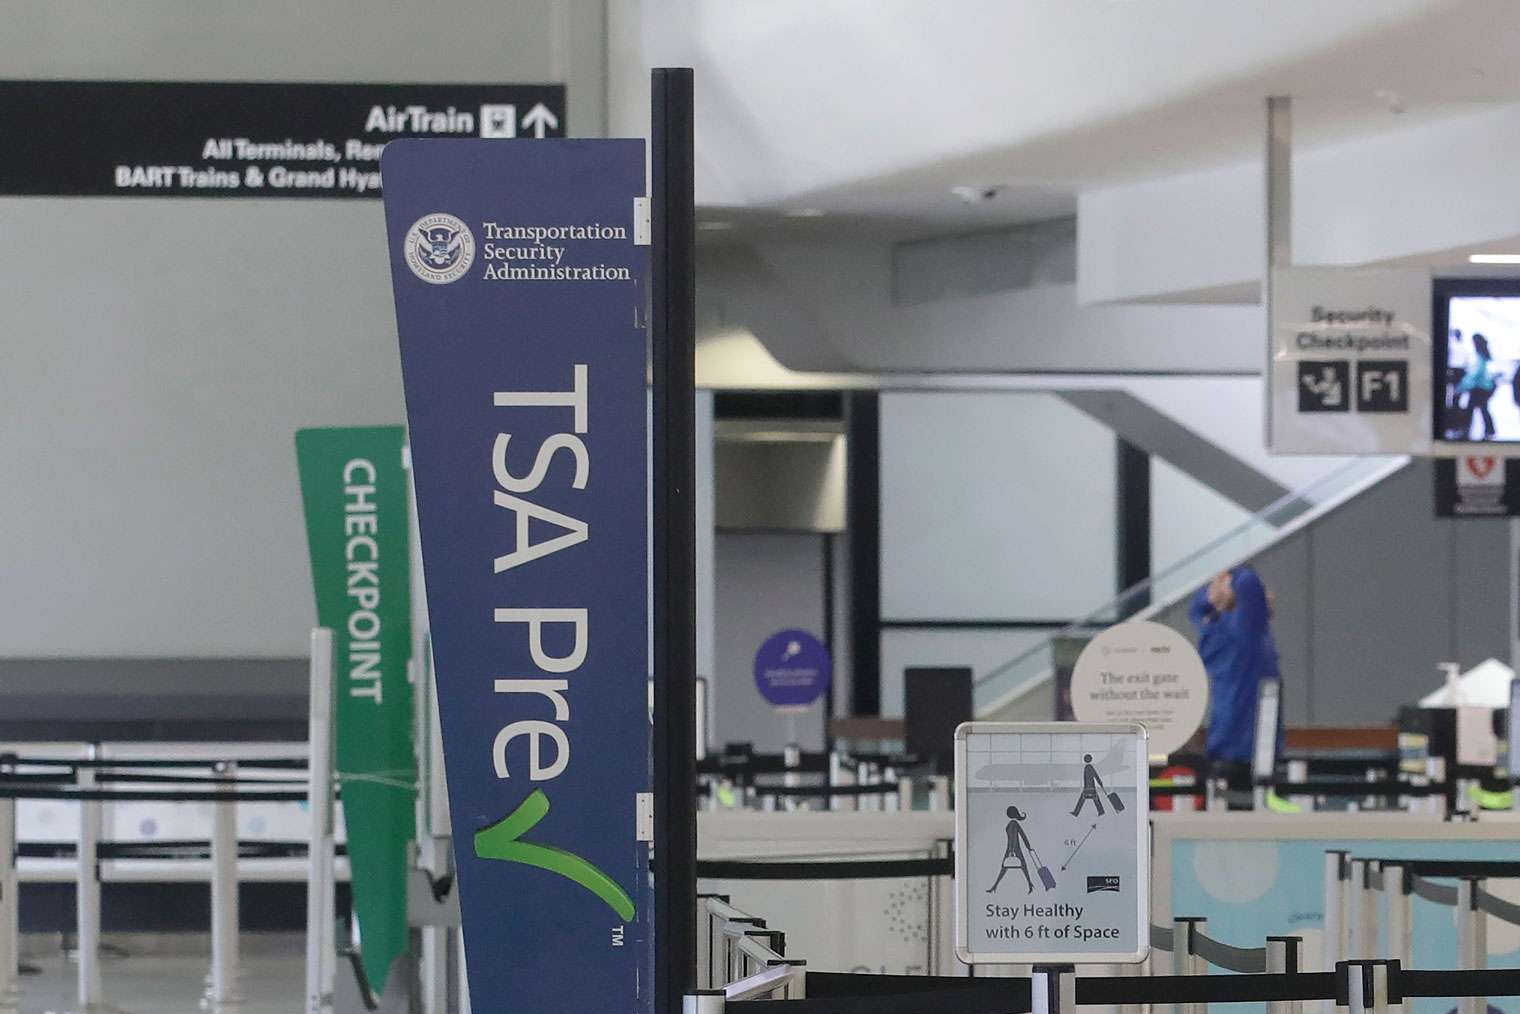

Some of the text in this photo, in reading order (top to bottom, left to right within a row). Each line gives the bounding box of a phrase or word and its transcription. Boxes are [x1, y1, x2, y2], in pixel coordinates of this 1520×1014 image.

[116, 166, 175, 188] BART
[179, 166, 240, 188] Trains
[245, 166, 264, 188] &
[269, 166, 334, 188] Grand
[483, 222, 627, 244] Transportation
[484, 243, 565, 264] Security
[483, 262, 630, 282] Administration
[1311, 306, 1394, 326] Security
[1297, 333, 1409, 353] Checkpoint
[1362, 371, 1401, 400] F1
[342, 457, 384, 704] CHECKPOINT
[492, 364, 590, 782] TSA Pre
[1101, 672, 1124, 684] The
[1127, 672, 1150, 684] exit
[1090, 689, 1190, 701] without the wait
[986, 903, 1084, 920] Stay Healthy
[611, 925, 625, 947] TM
[986, 925, 1120, 941] with 6 ft of Space
